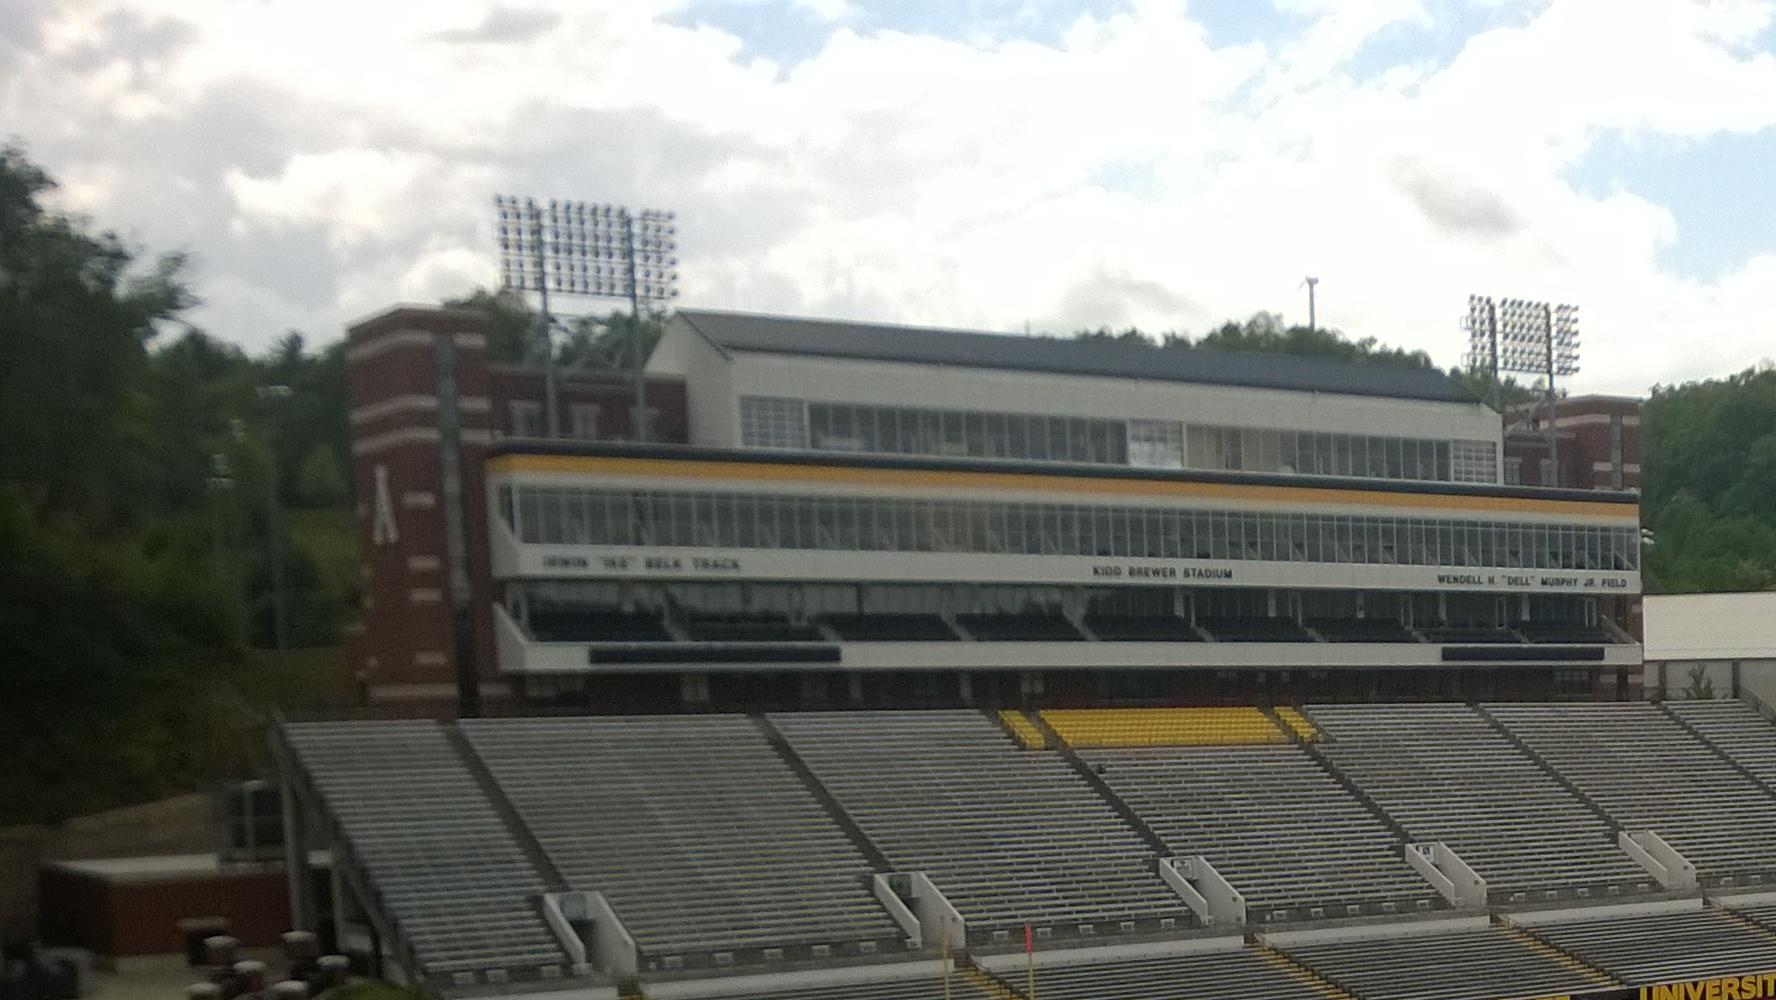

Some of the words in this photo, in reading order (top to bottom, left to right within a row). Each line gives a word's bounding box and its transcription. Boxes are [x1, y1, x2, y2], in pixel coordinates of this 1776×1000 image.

[1093, 566, 1121, 577] KIDD
[1128, 566, 1176, 578] BREWER
[1183, 567, 1232, 579] STADIUM
[1437, 574, 1483, 586] WENDELL
[1541, 576, 1577, 588] MURPHY
[1601, 578, 1628, 588] FIELD
